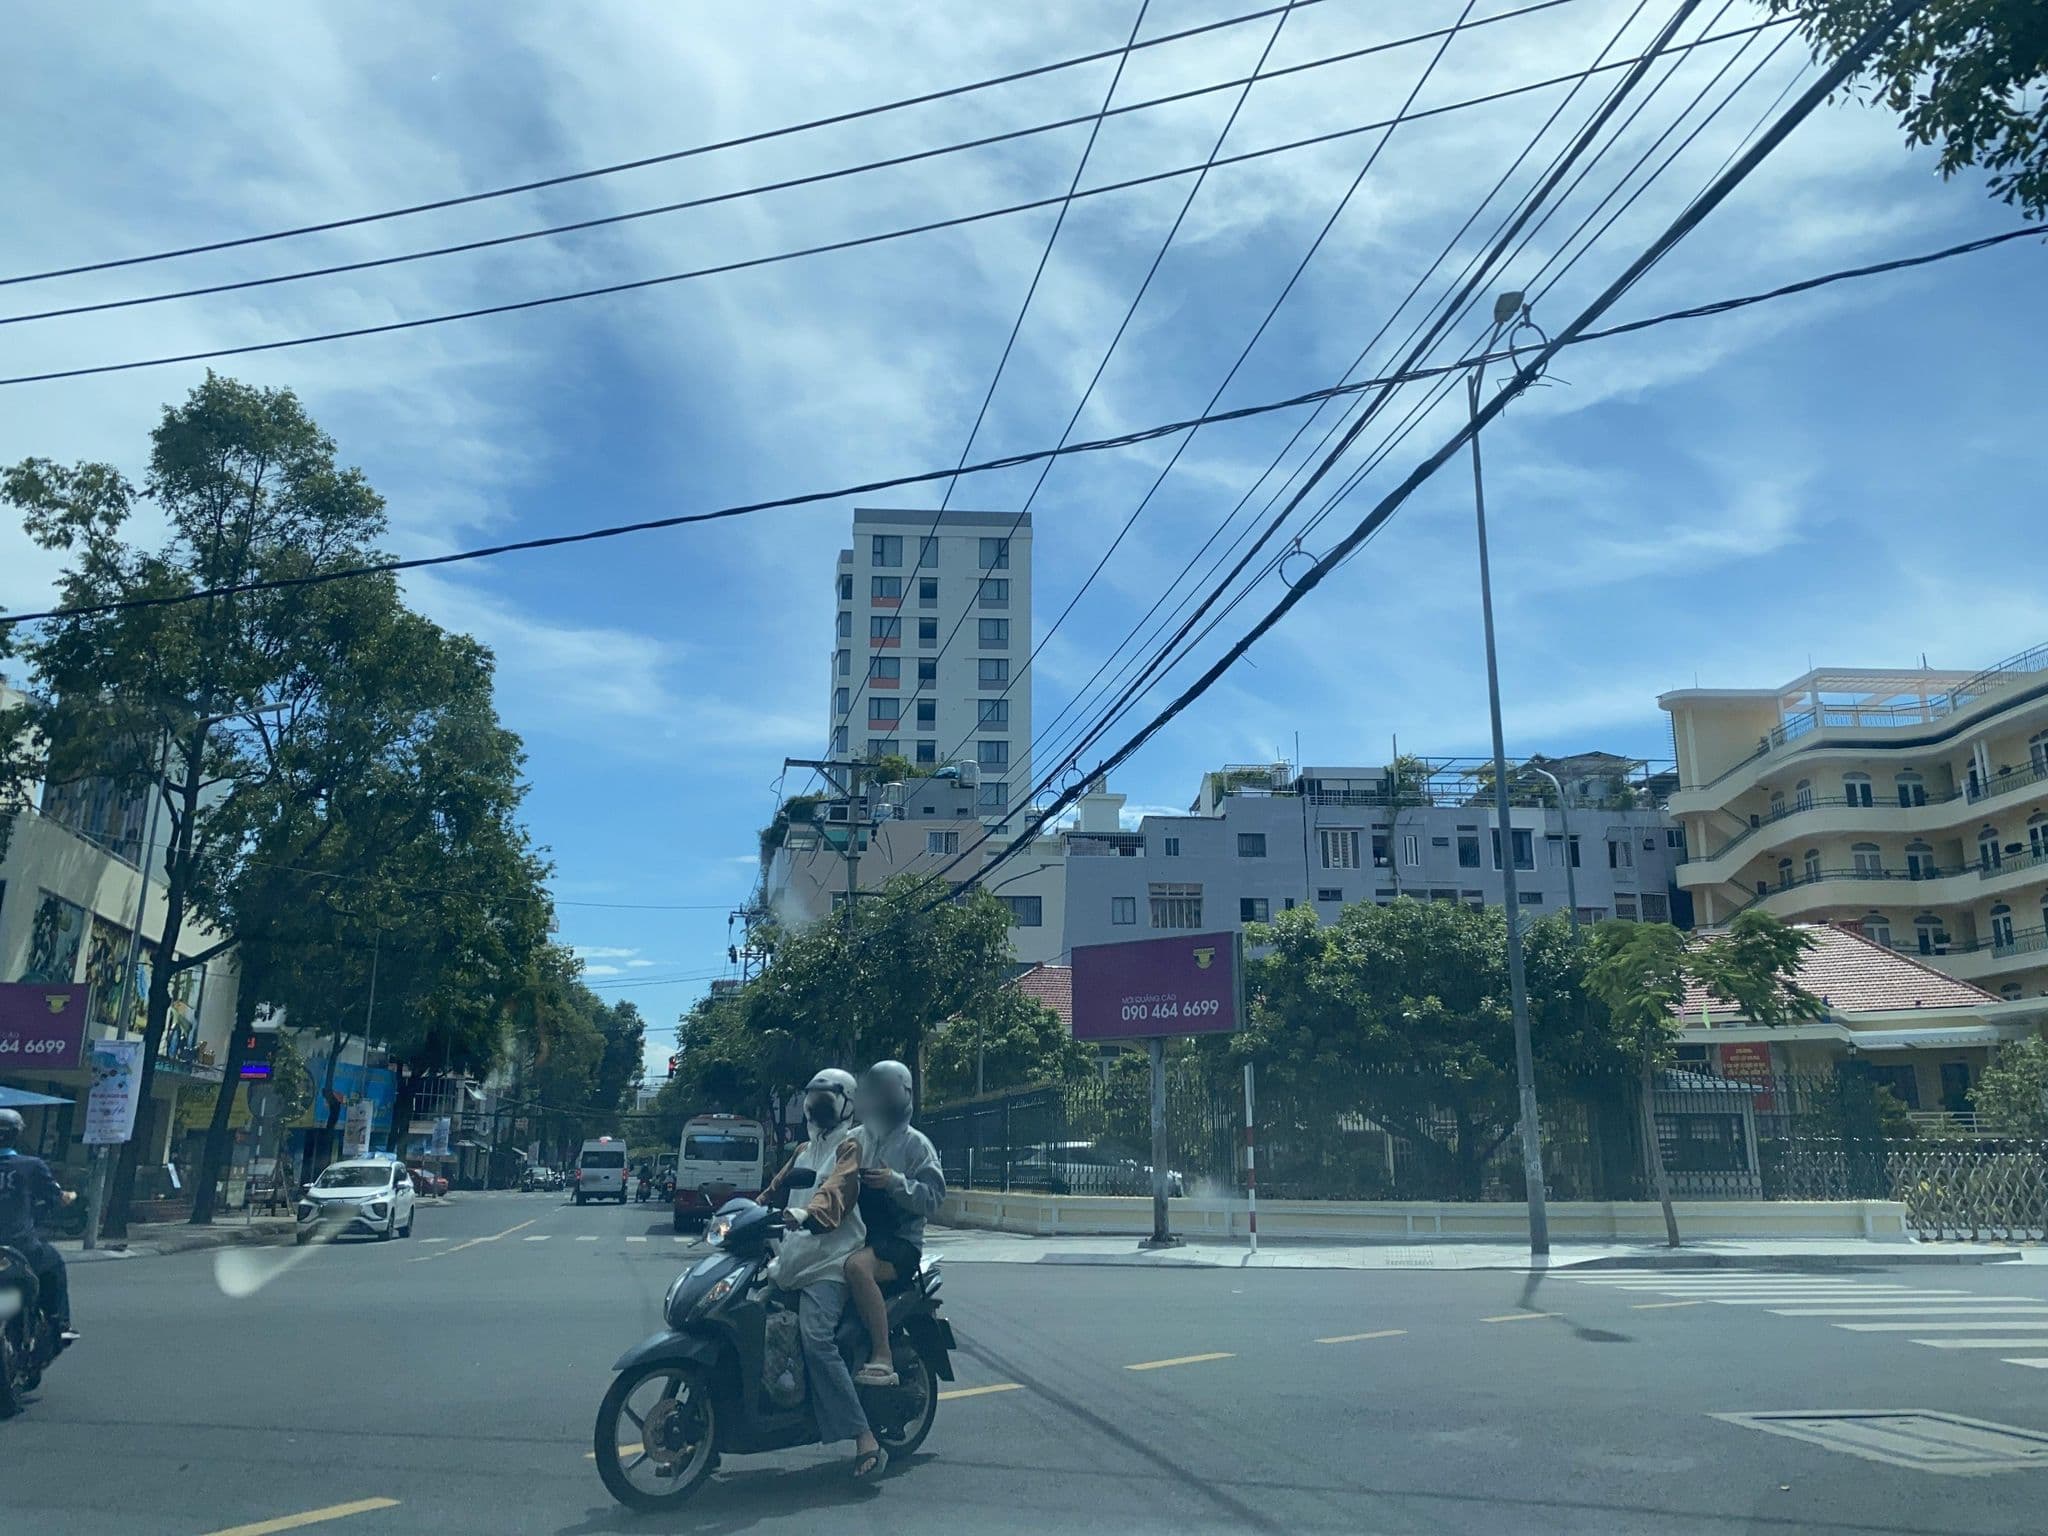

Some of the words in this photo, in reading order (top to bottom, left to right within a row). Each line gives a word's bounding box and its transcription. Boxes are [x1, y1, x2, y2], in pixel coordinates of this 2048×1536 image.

[1121, 1004, 1148, 1021] 090
[1151, 1002, 1178, 1018] 464
[1182, 1000, 1219, 1016] 6699
[24, 1039, 66, 1054] 6699
